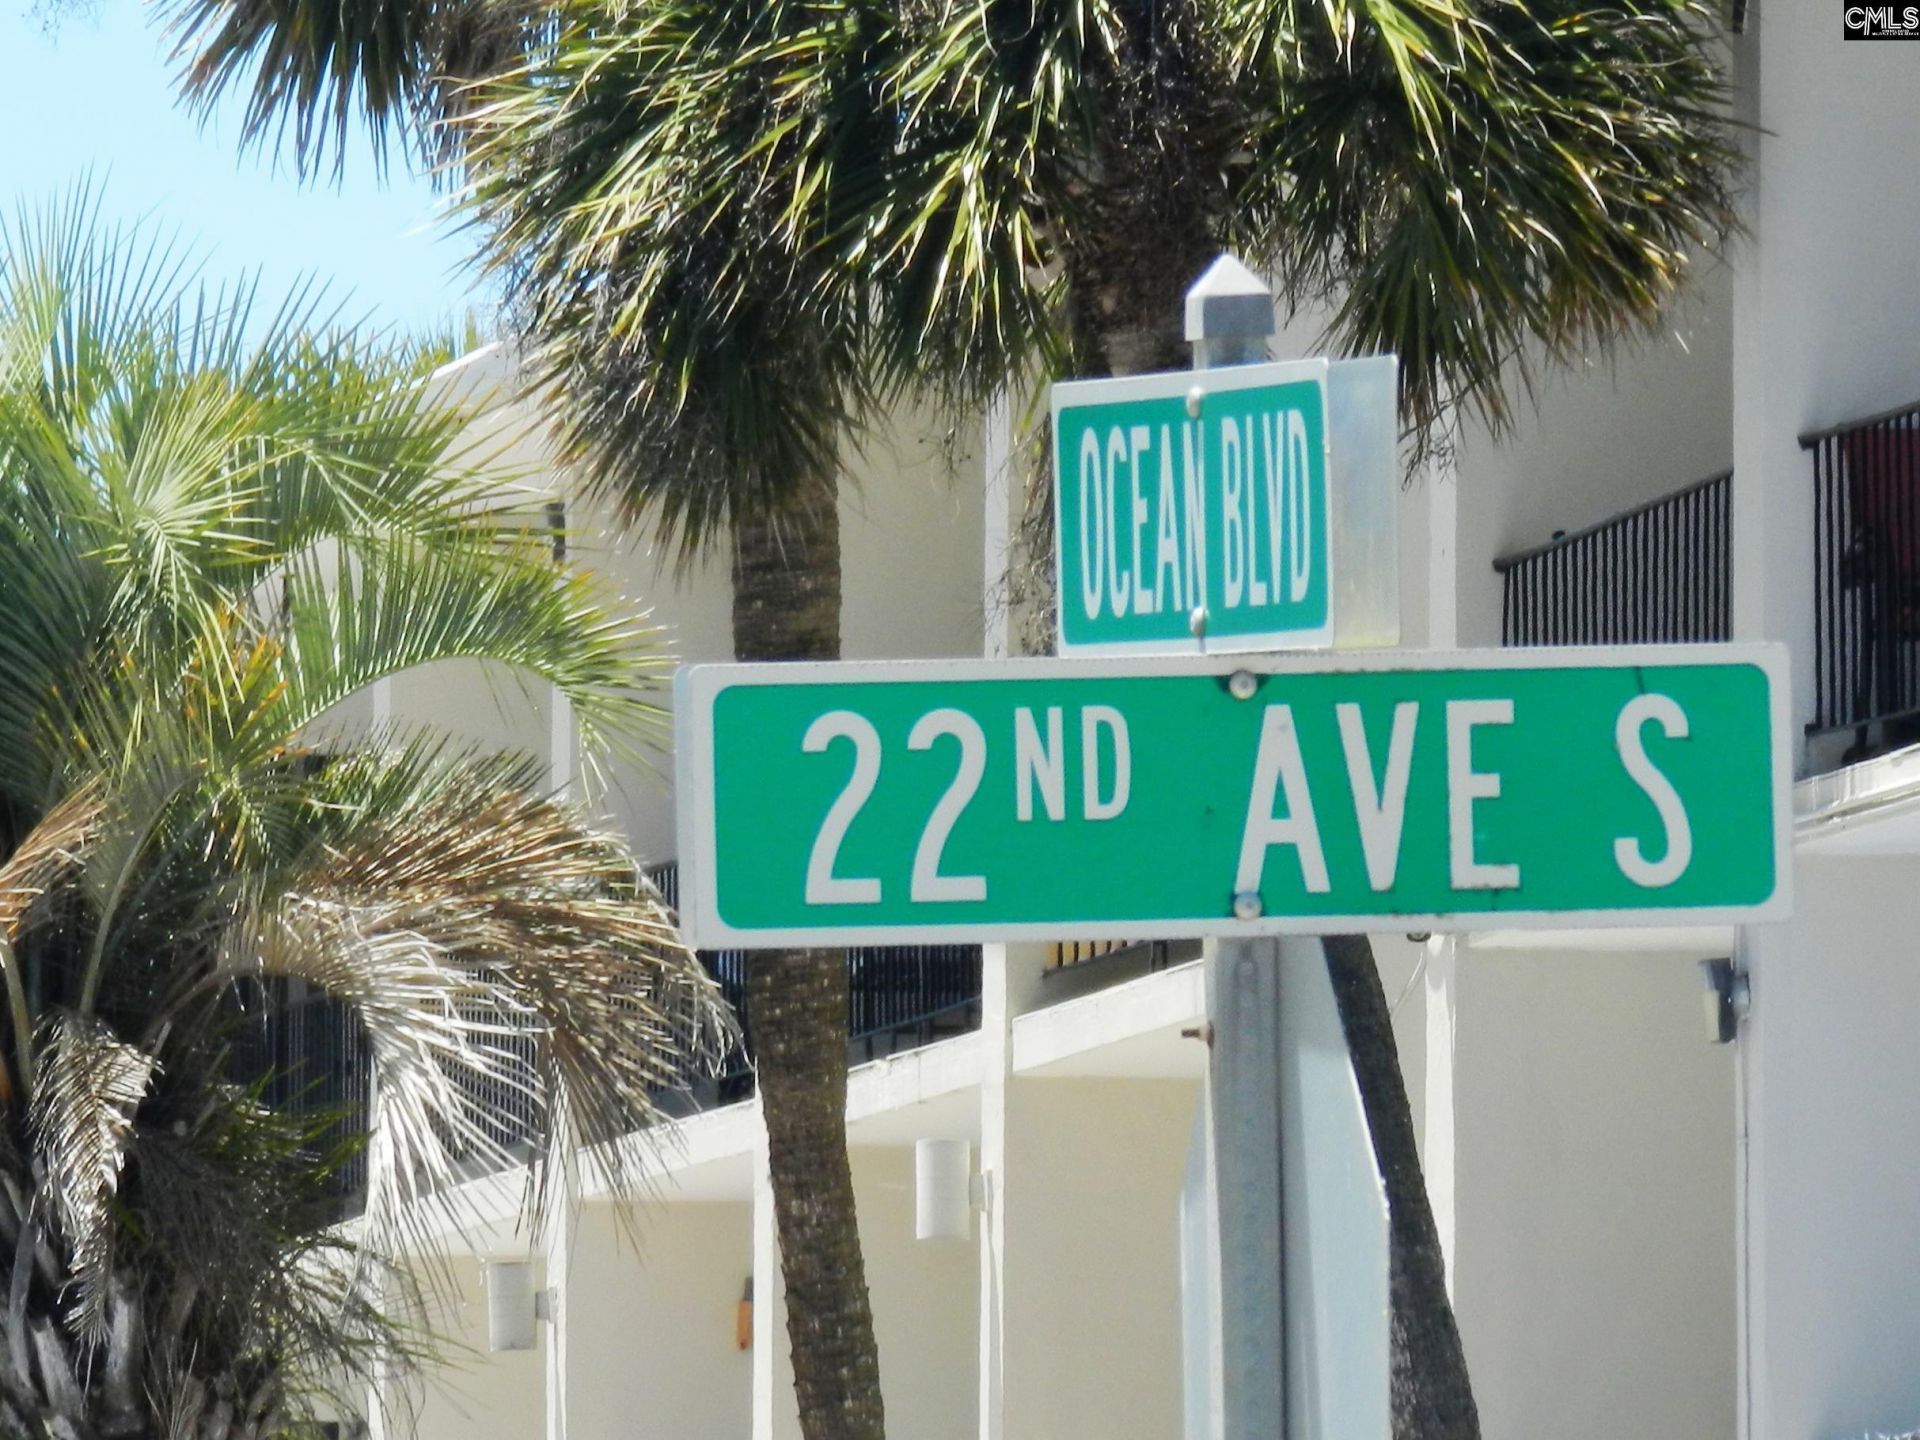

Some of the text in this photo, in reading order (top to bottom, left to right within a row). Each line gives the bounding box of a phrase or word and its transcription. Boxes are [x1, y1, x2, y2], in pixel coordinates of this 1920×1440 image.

[1080, 409, 1311, 620] OCEAN BLVD
[802, 693, 1692, 905] 22ND AVE S
